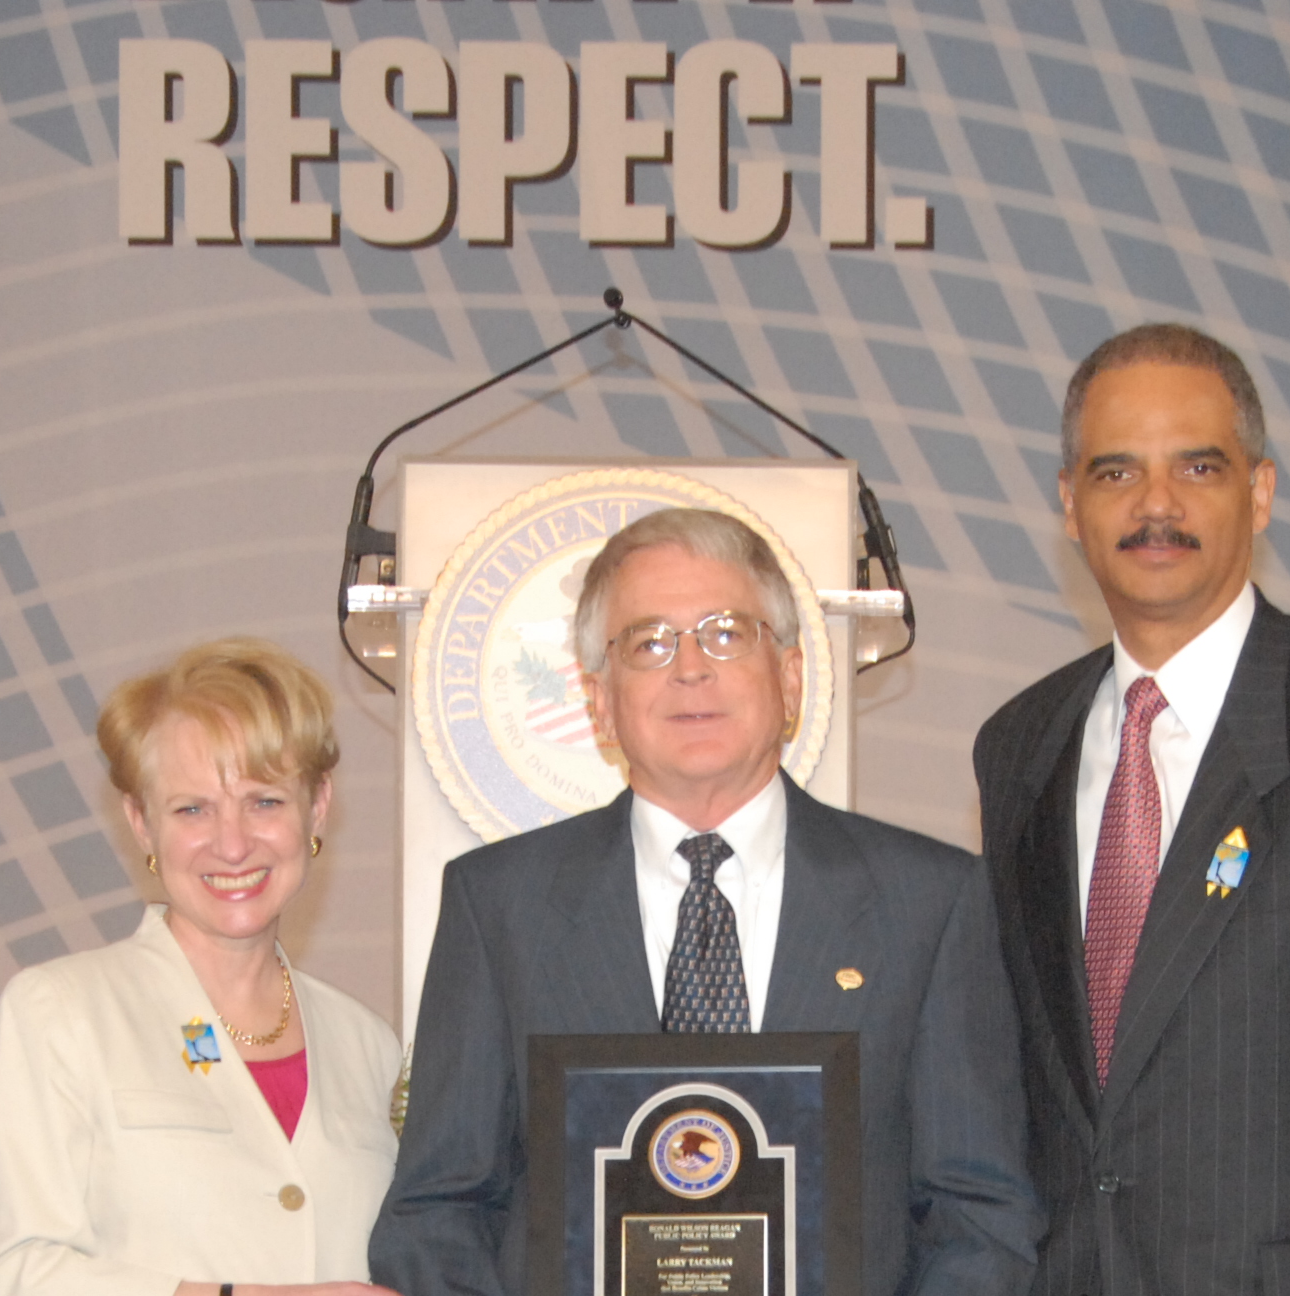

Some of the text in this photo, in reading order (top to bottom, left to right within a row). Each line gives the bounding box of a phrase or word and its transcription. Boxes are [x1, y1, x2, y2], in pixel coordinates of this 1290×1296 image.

[119, 37, 931, 249] RESPECT.
[445, 500, 638, 724] DEPARTMENT
[500, 711, 525, 750] PRO
[525, 753, 598, 806] DOMINA
[657, 1257, 686, 1267] LARRY
